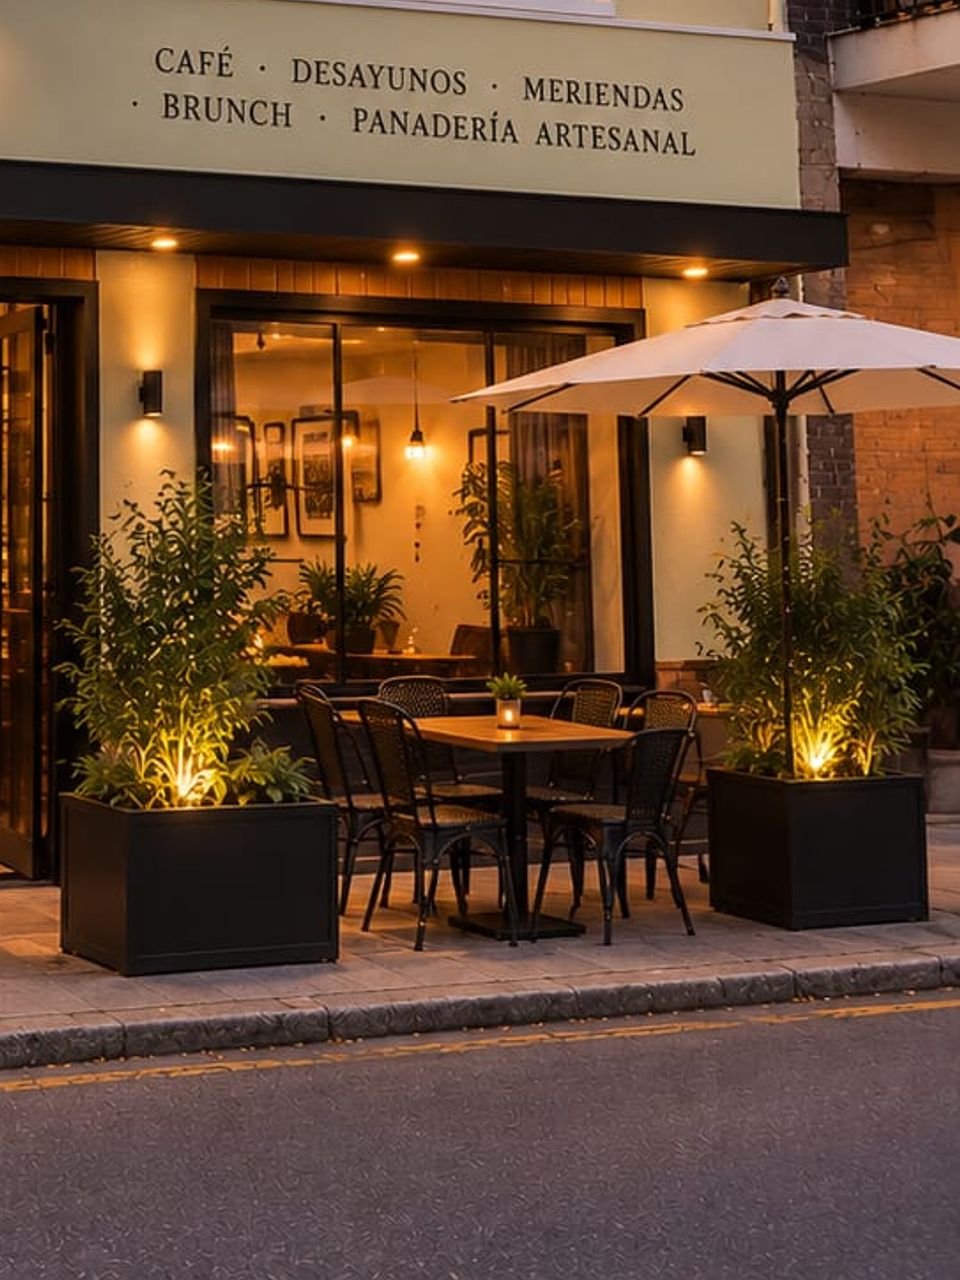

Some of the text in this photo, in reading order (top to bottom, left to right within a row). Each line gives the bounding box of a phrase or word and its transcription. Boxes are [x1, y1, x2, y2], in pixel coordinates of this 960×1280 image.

[154, 45, 684, 113] CAFÉ DESAYUNOS MERIENDAS
[162, 92, 696, 157] BRUNCH PANADERÍA ARTESANAL
